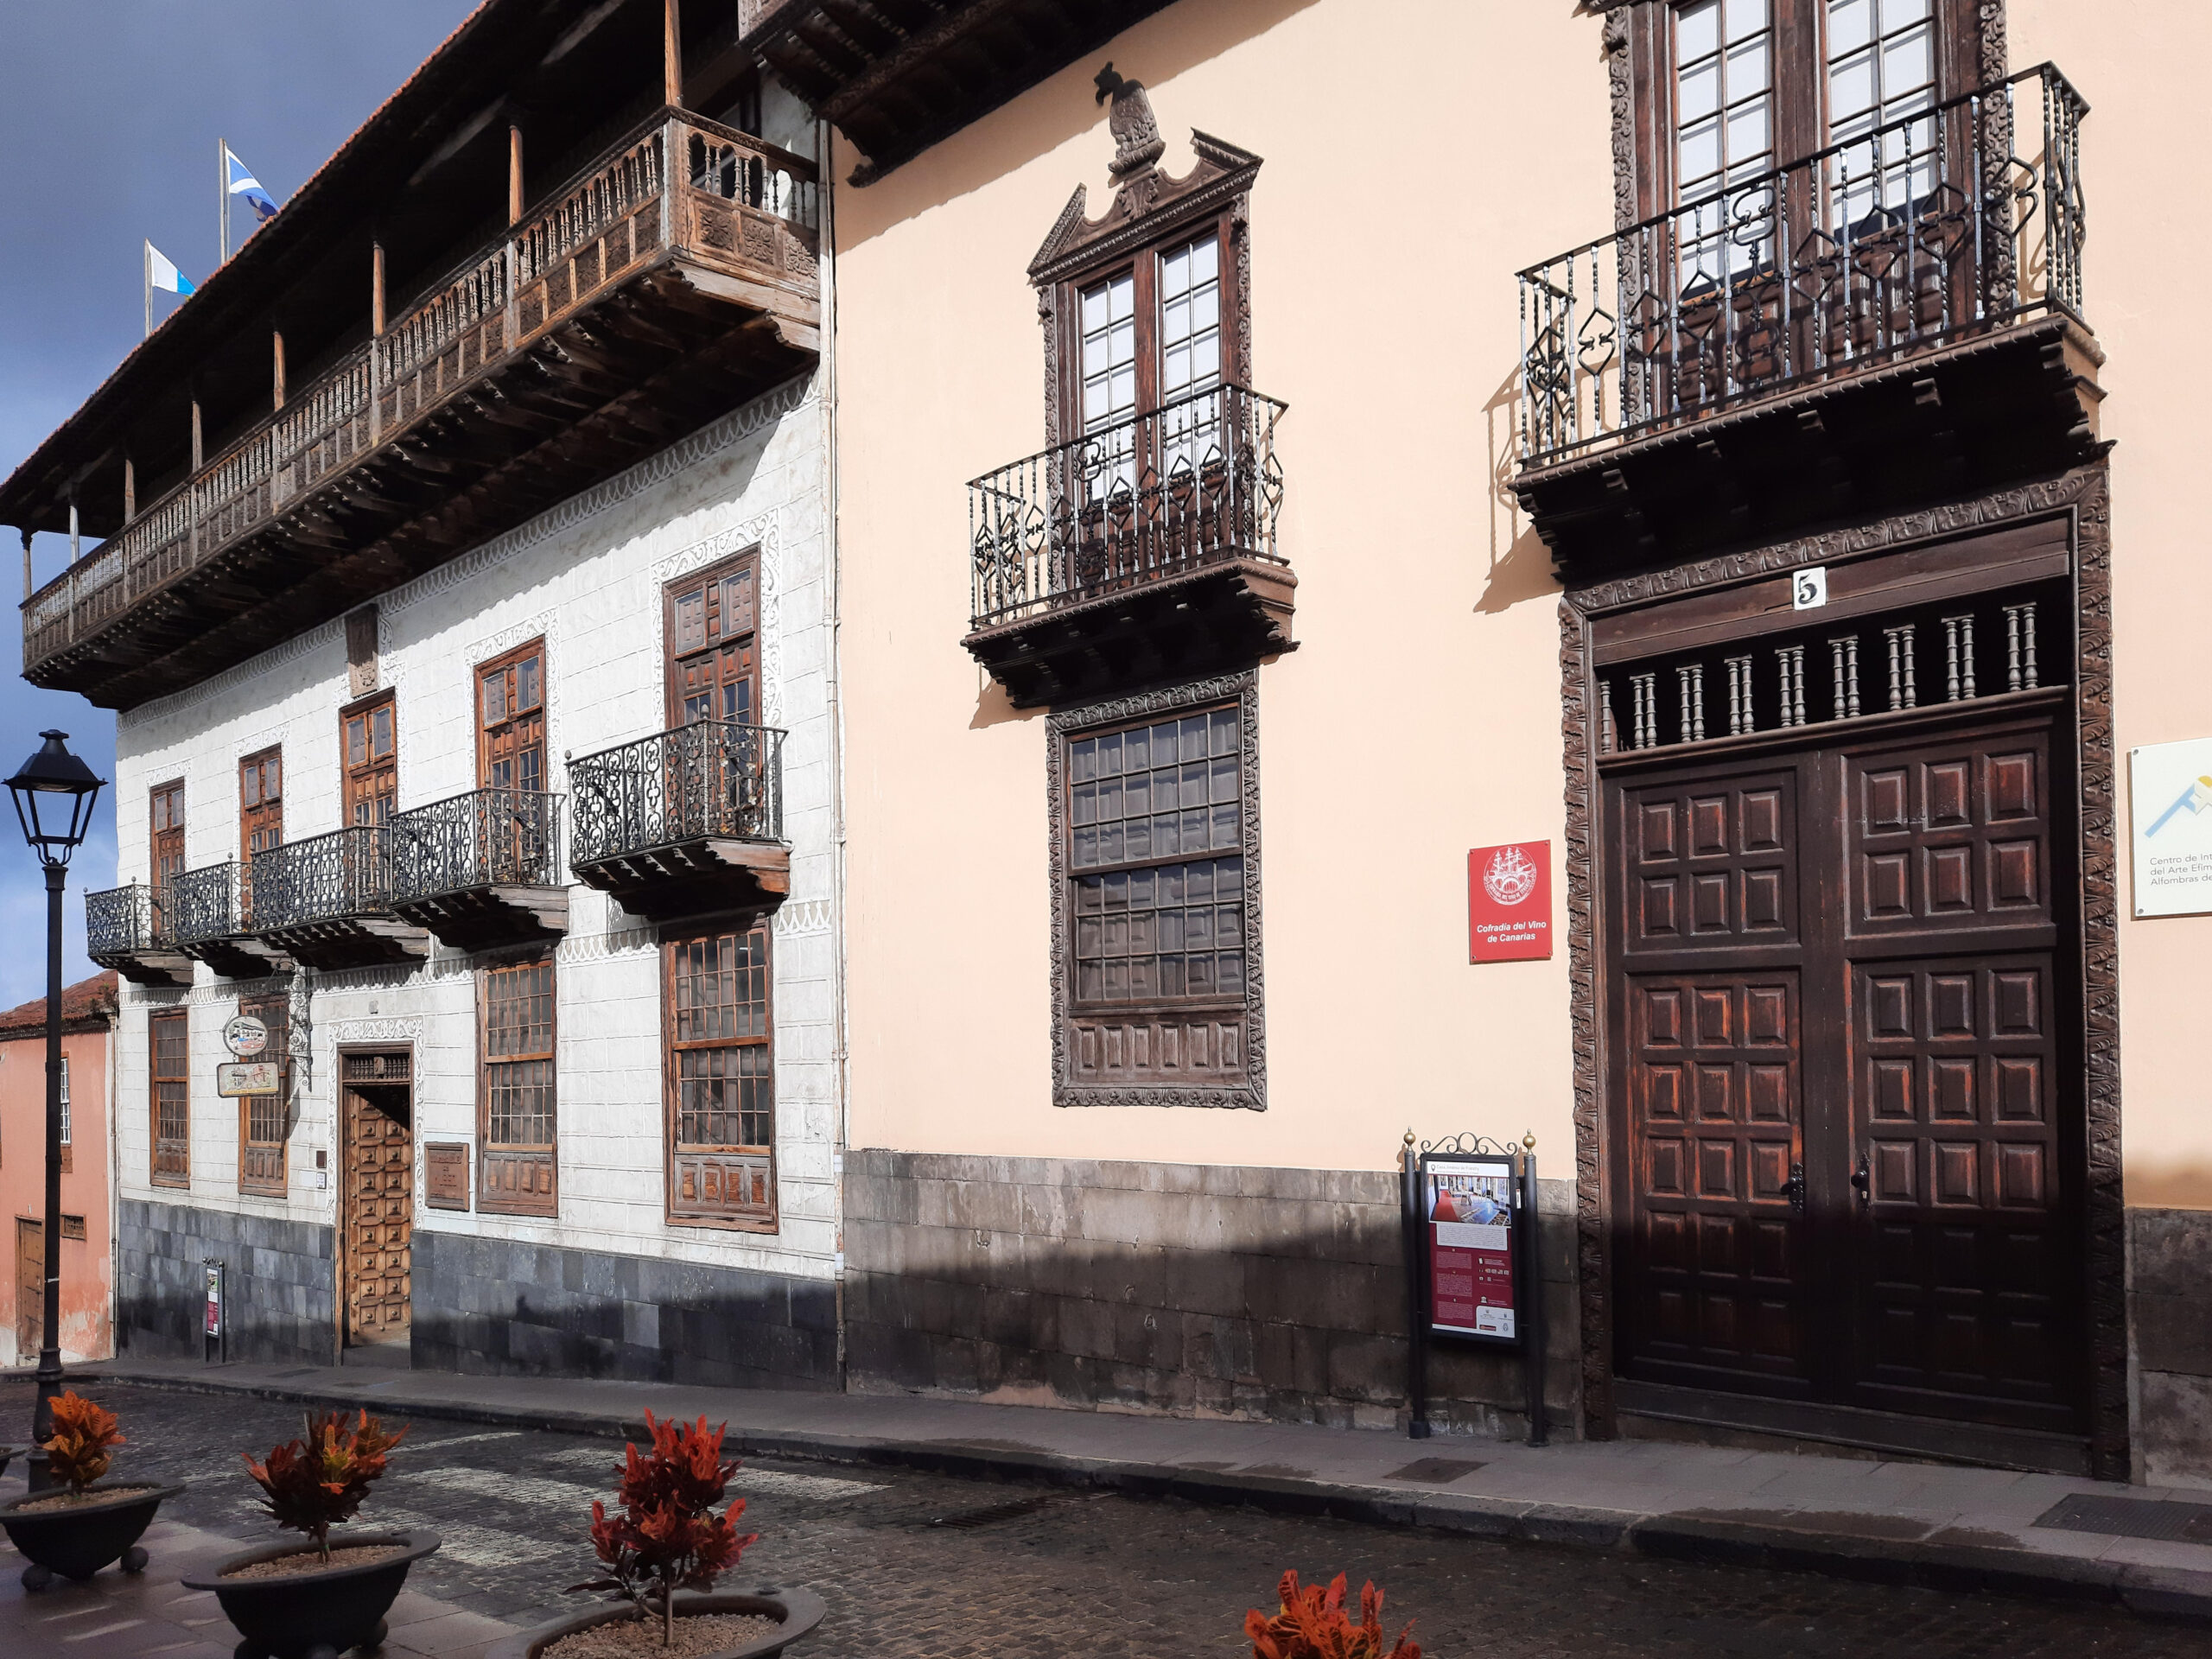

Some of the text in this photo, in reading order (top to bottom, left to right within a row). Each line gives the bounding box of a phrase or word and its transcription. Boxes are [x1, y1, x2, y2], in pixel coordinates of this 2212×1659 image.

[1798, 573, 1817, 605] 5
[2150, 867, 2165, 875] del
[2151, 876, 2199, 885] Alfombras
[1513, 921, 1527, 931] del
[1528, 920, 1547, 929] Vino
[1499, 932, 1535, 942] Canarias
